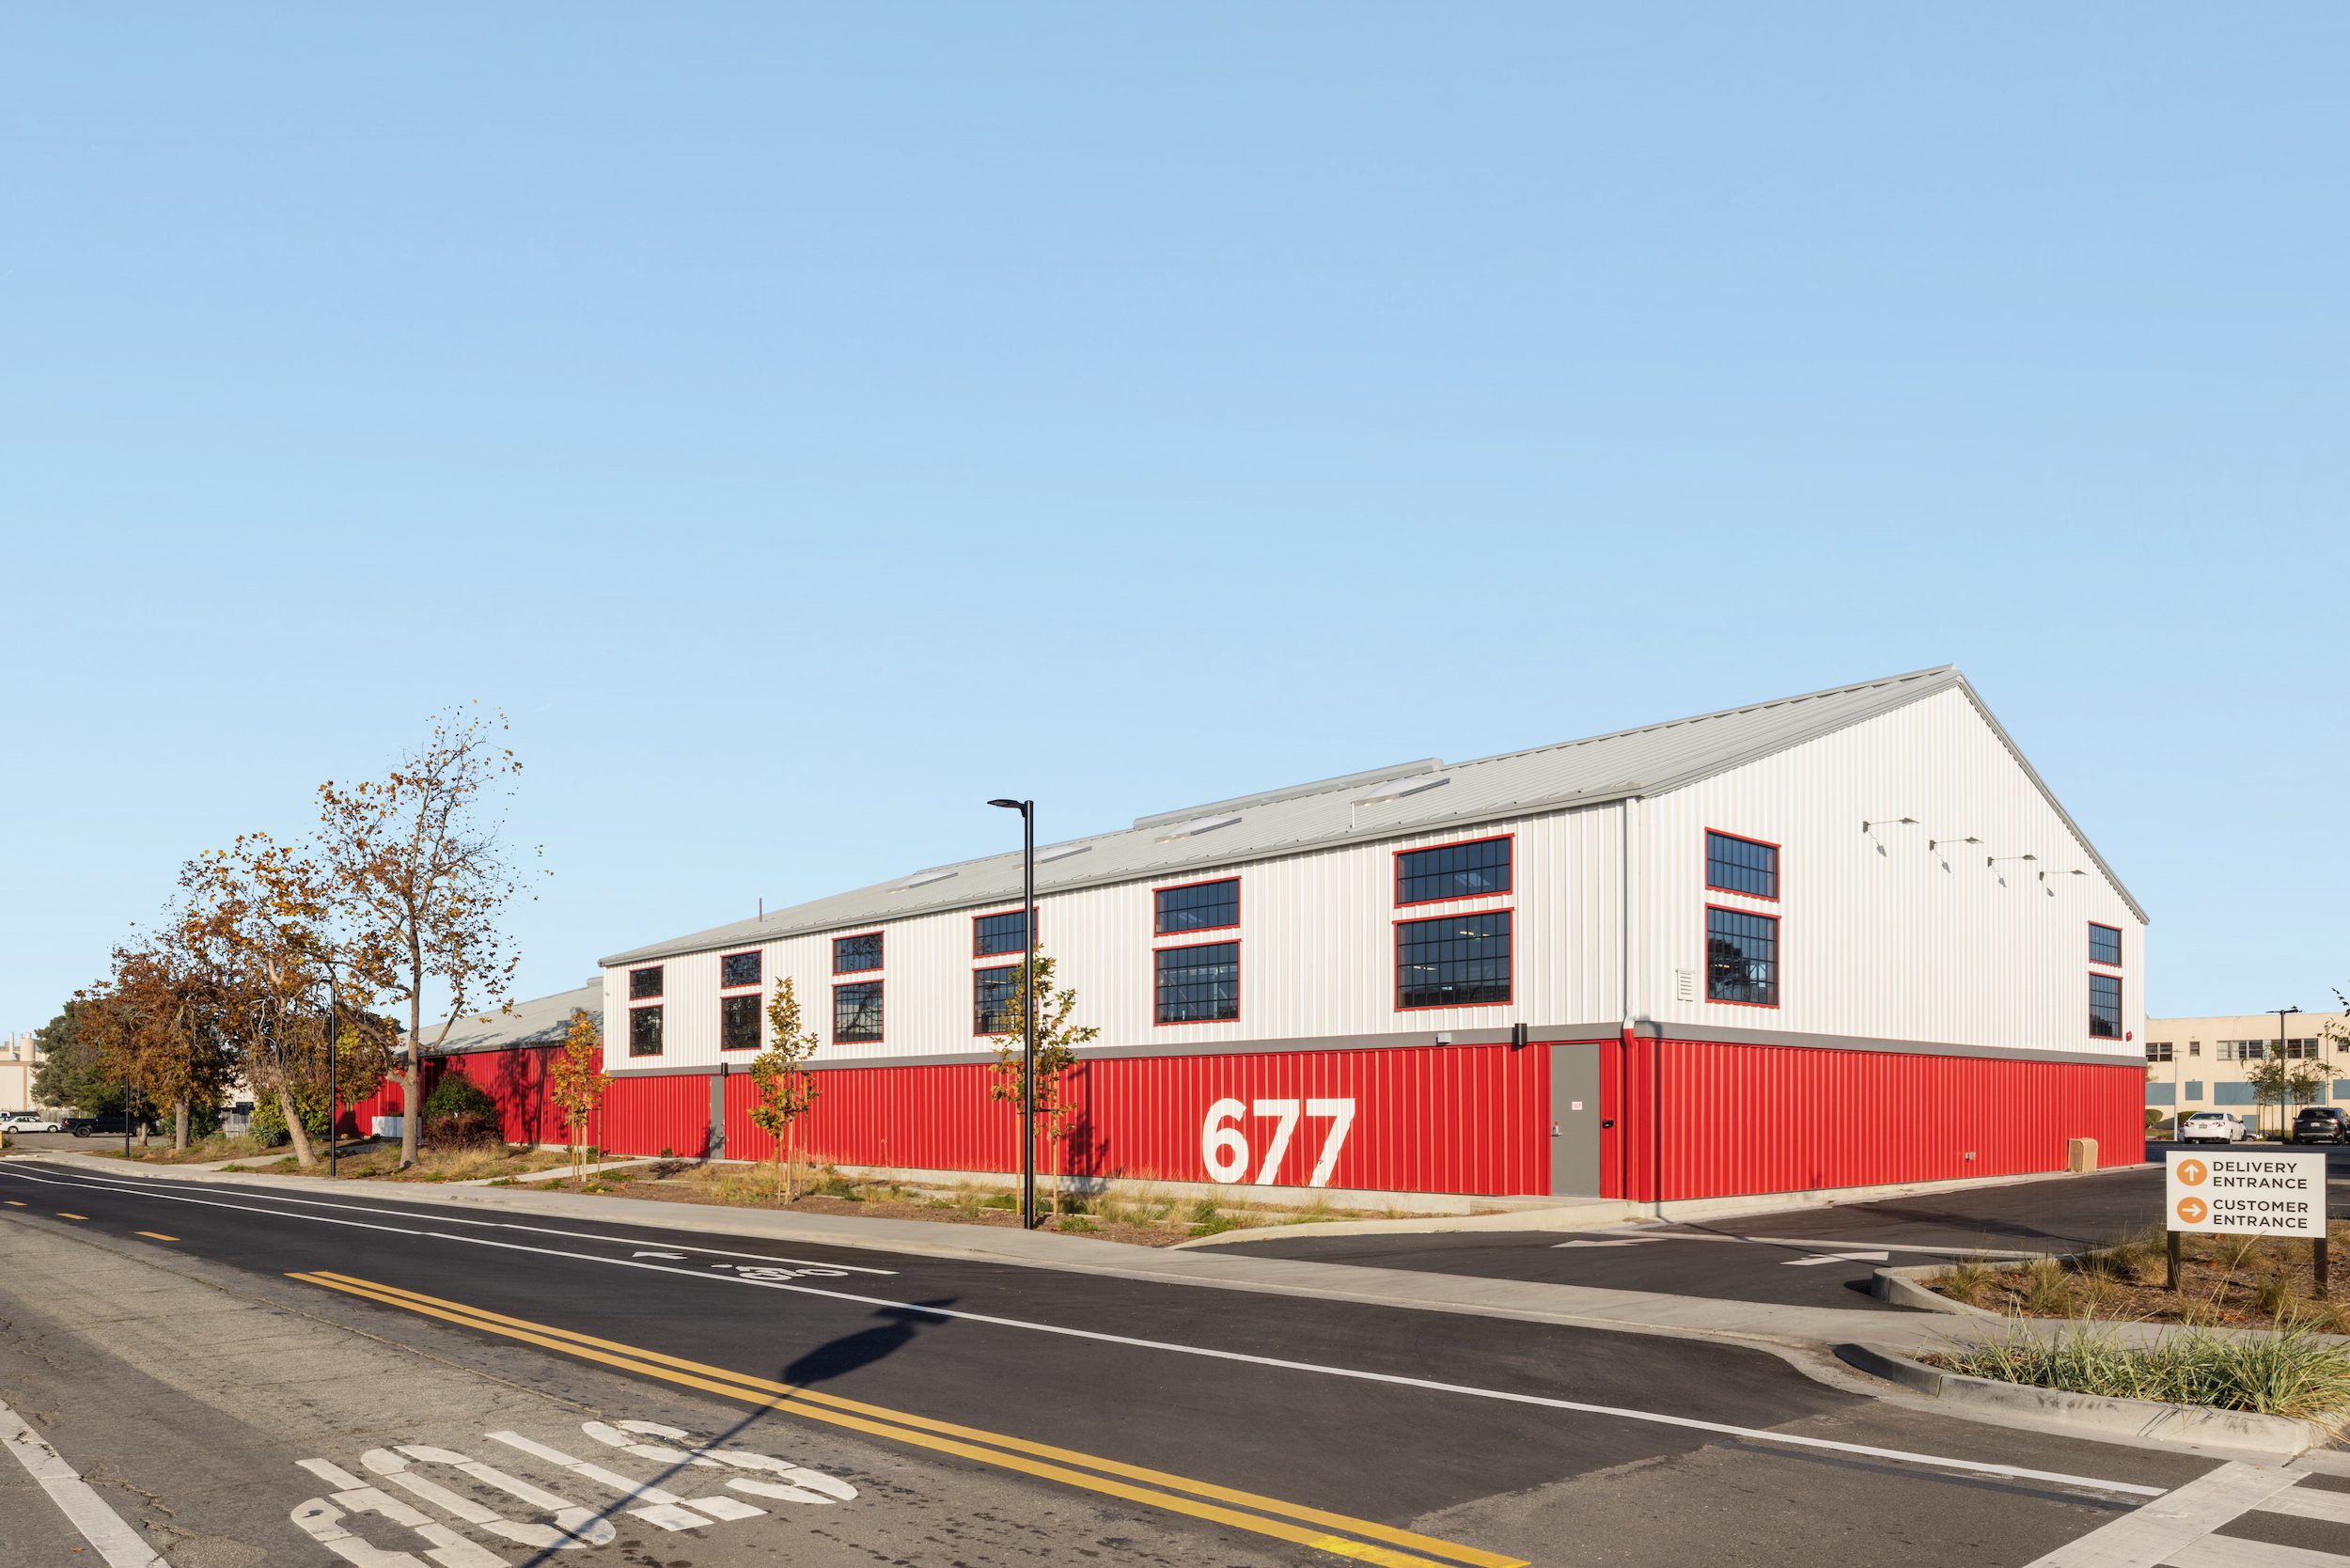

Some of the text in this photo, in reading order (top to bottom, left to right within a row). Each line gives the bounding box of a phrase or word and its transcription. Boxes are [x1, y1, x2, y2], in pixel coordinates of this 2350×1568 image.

[1202, 1098, 1355, 1187] 677
[2213, 1161, 2297, 1173] DELIVERY
[2213, 1176, 2308, 1189] ENTRANCE
[2213, 1199, 2309, 1213] CUSTOMER
[2213, 1215, 2308, 1229] ENTRANCE
[290, 1419, 858, 1568] STOP
